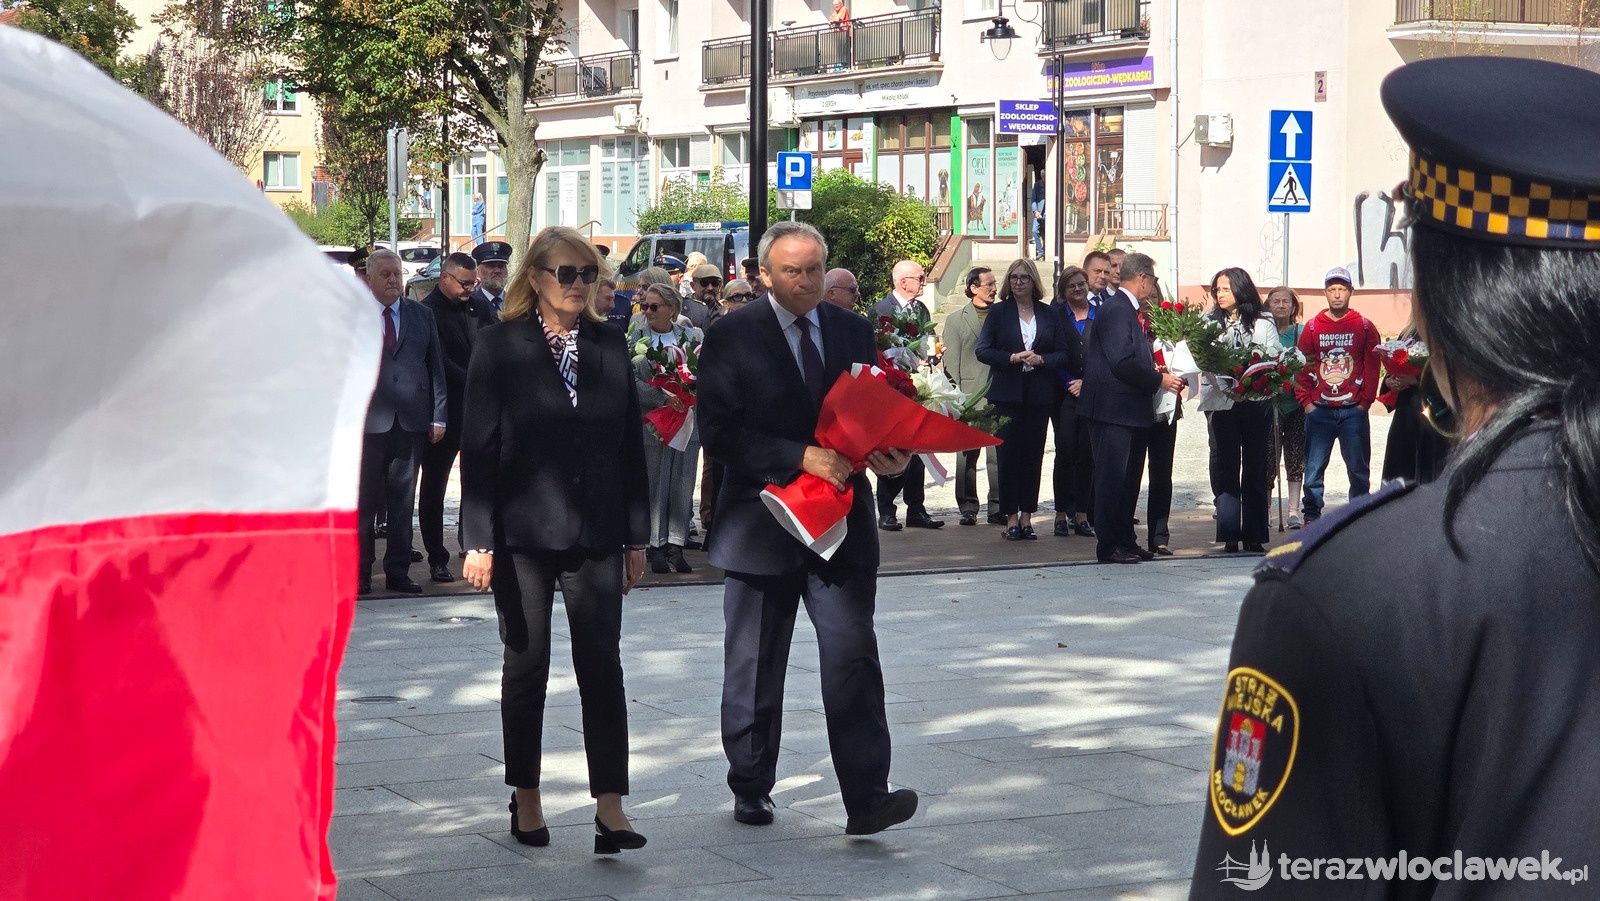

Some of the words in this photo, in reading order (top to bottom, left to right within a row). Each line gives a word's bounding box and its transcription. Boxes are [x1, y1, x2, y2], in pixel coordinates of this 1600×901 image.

[1318, 80, 1324, 94] 2
[1000, 112, 1058, 121] ZOOLOGICZNO-
[1008, 124, 1054, 132] WĘDKARSKI
[785, 156, 806, 186] P
[1320, 333, 1354, 341] NAUGHTY
